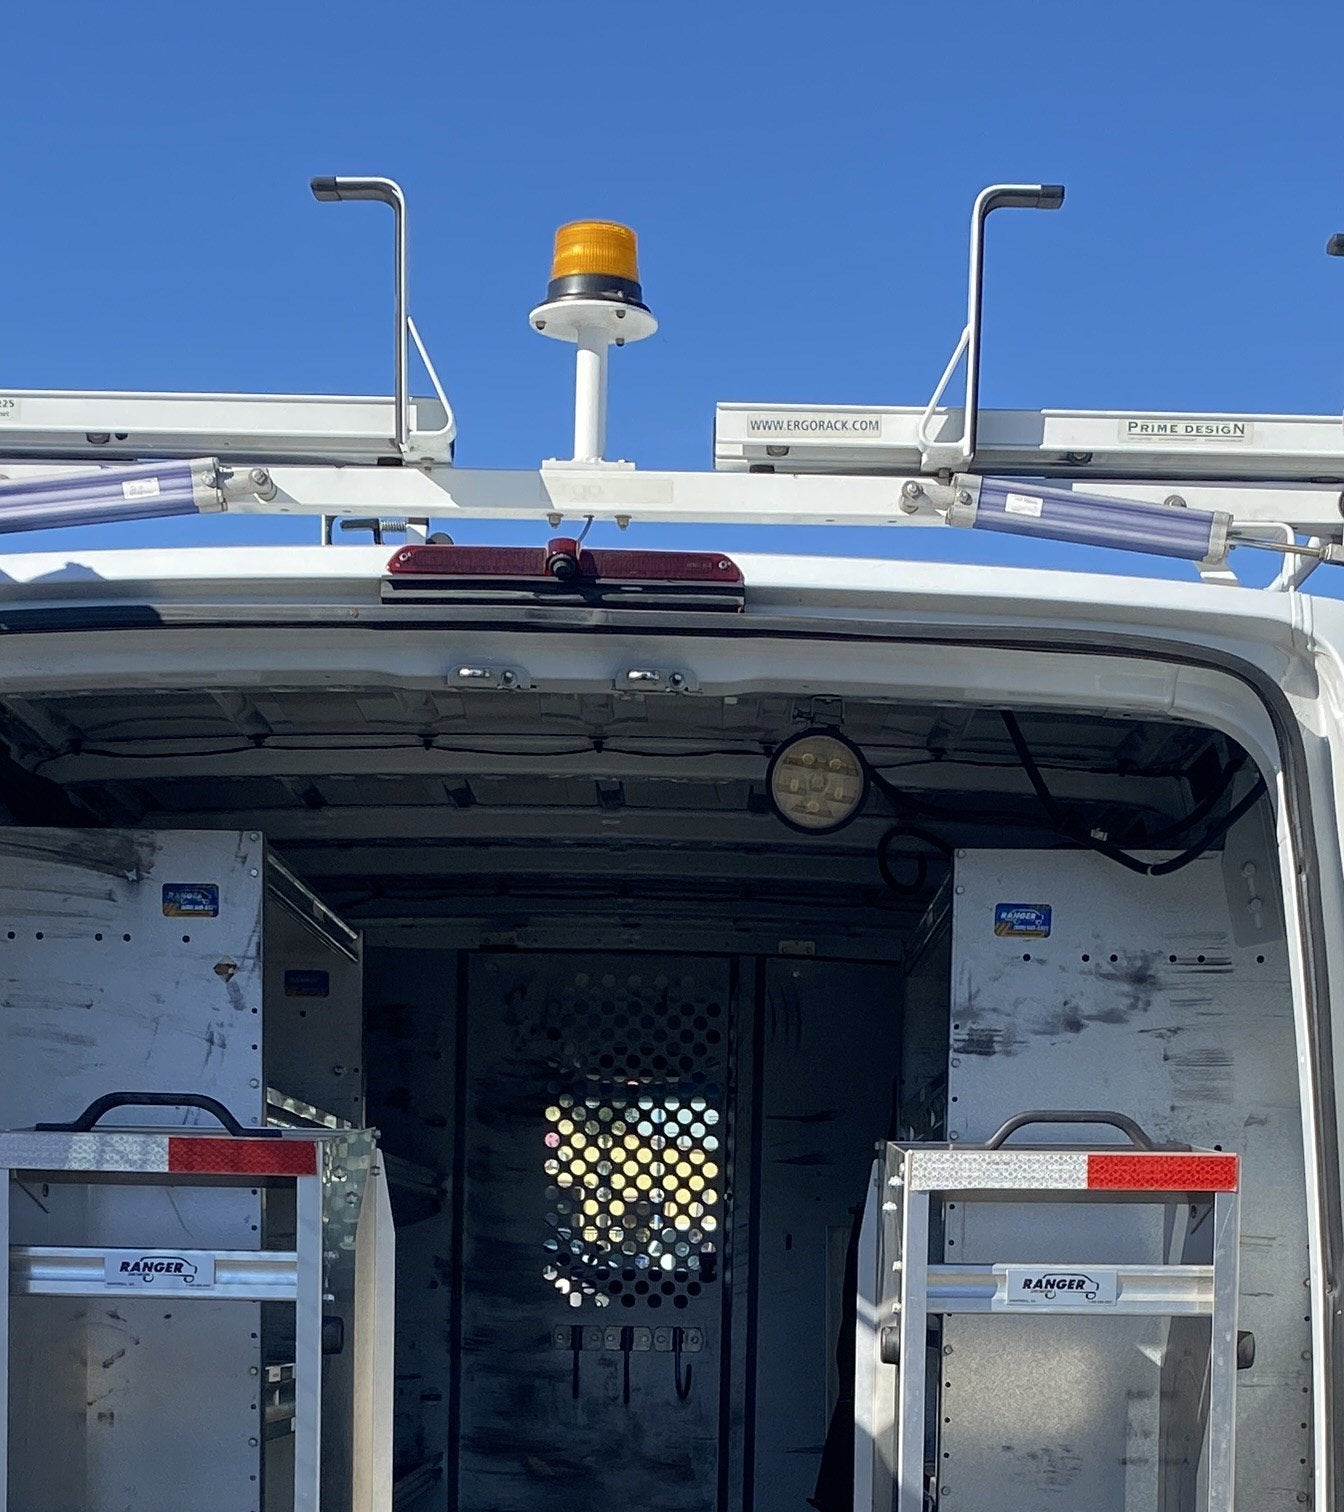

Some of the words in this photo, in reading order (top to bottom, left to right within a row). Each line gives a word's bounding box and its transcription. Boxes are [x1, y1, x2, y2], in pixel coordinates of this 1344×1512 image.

[750, 419, 880, 432] WWW.ERGORACK.COM
[1000, 911, 1037, 920] RANGER
[119, 1261, 184, 1274] RANGER
[1022, 1278, 1086, 1290] RANGER
